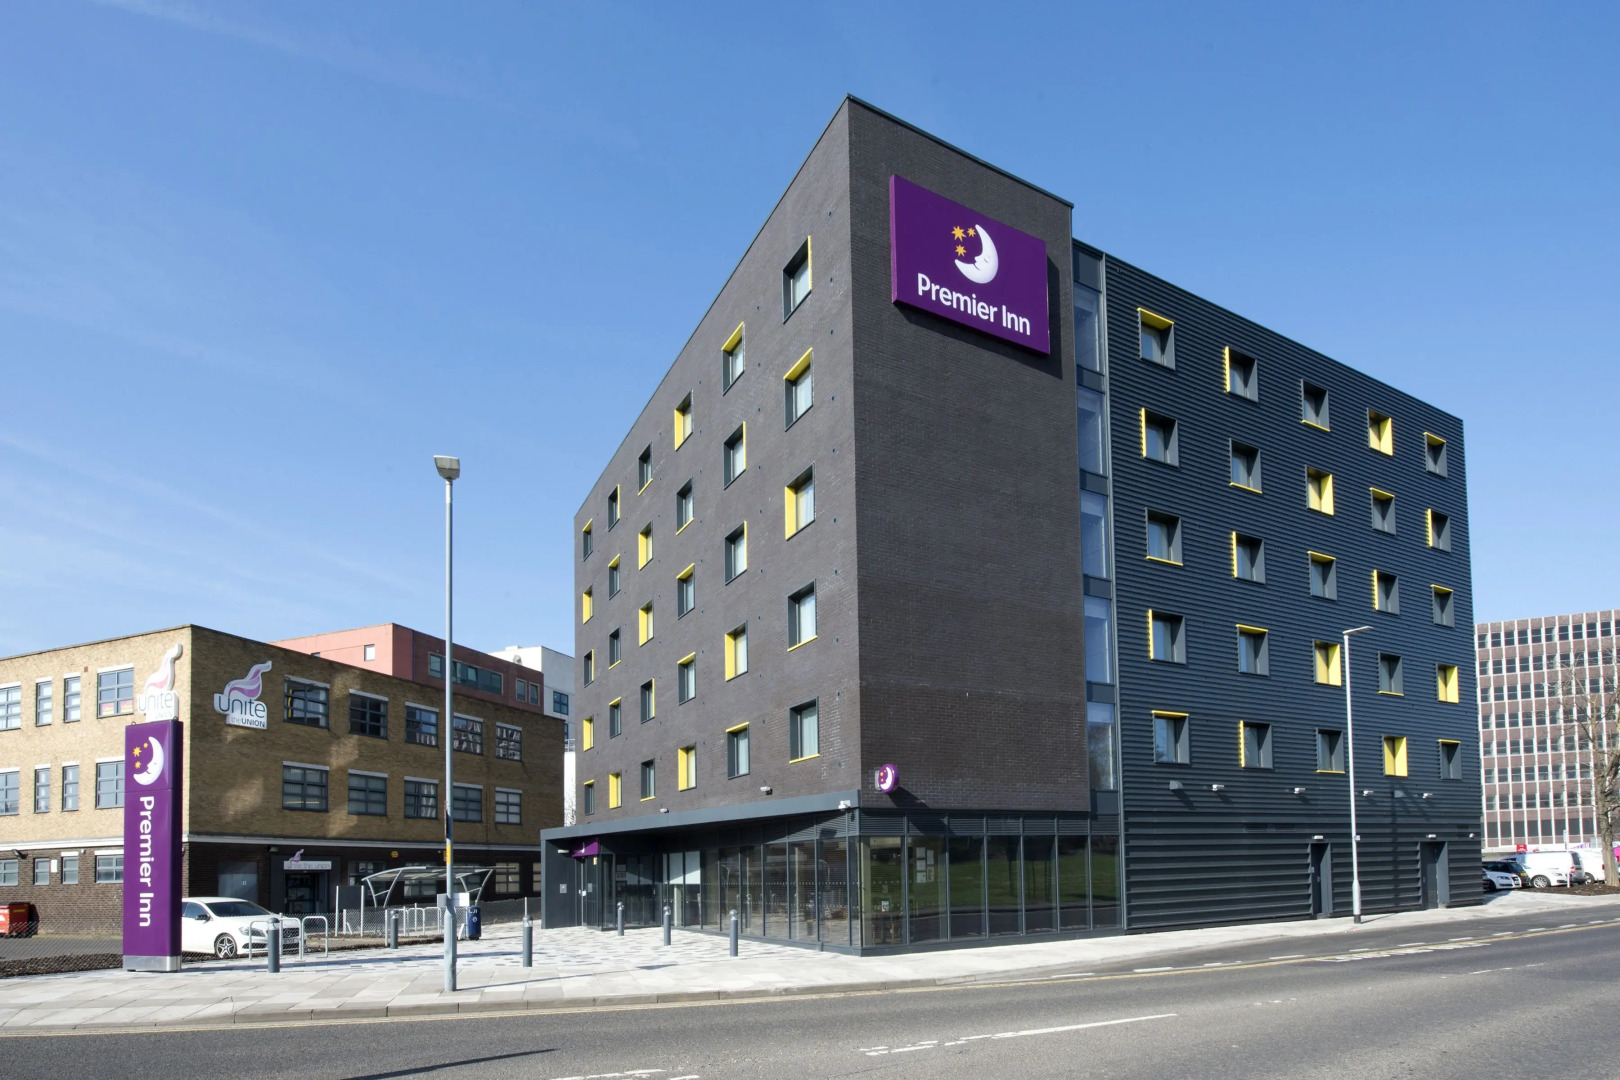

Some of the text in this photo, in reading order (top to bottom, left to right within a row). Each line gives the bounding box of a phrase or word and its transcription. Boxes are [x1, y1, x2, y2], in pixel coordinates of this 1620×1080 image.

[917, 272, 1031, 336] Premier Inn
[138, 796, 155, 927] Premier Inn
